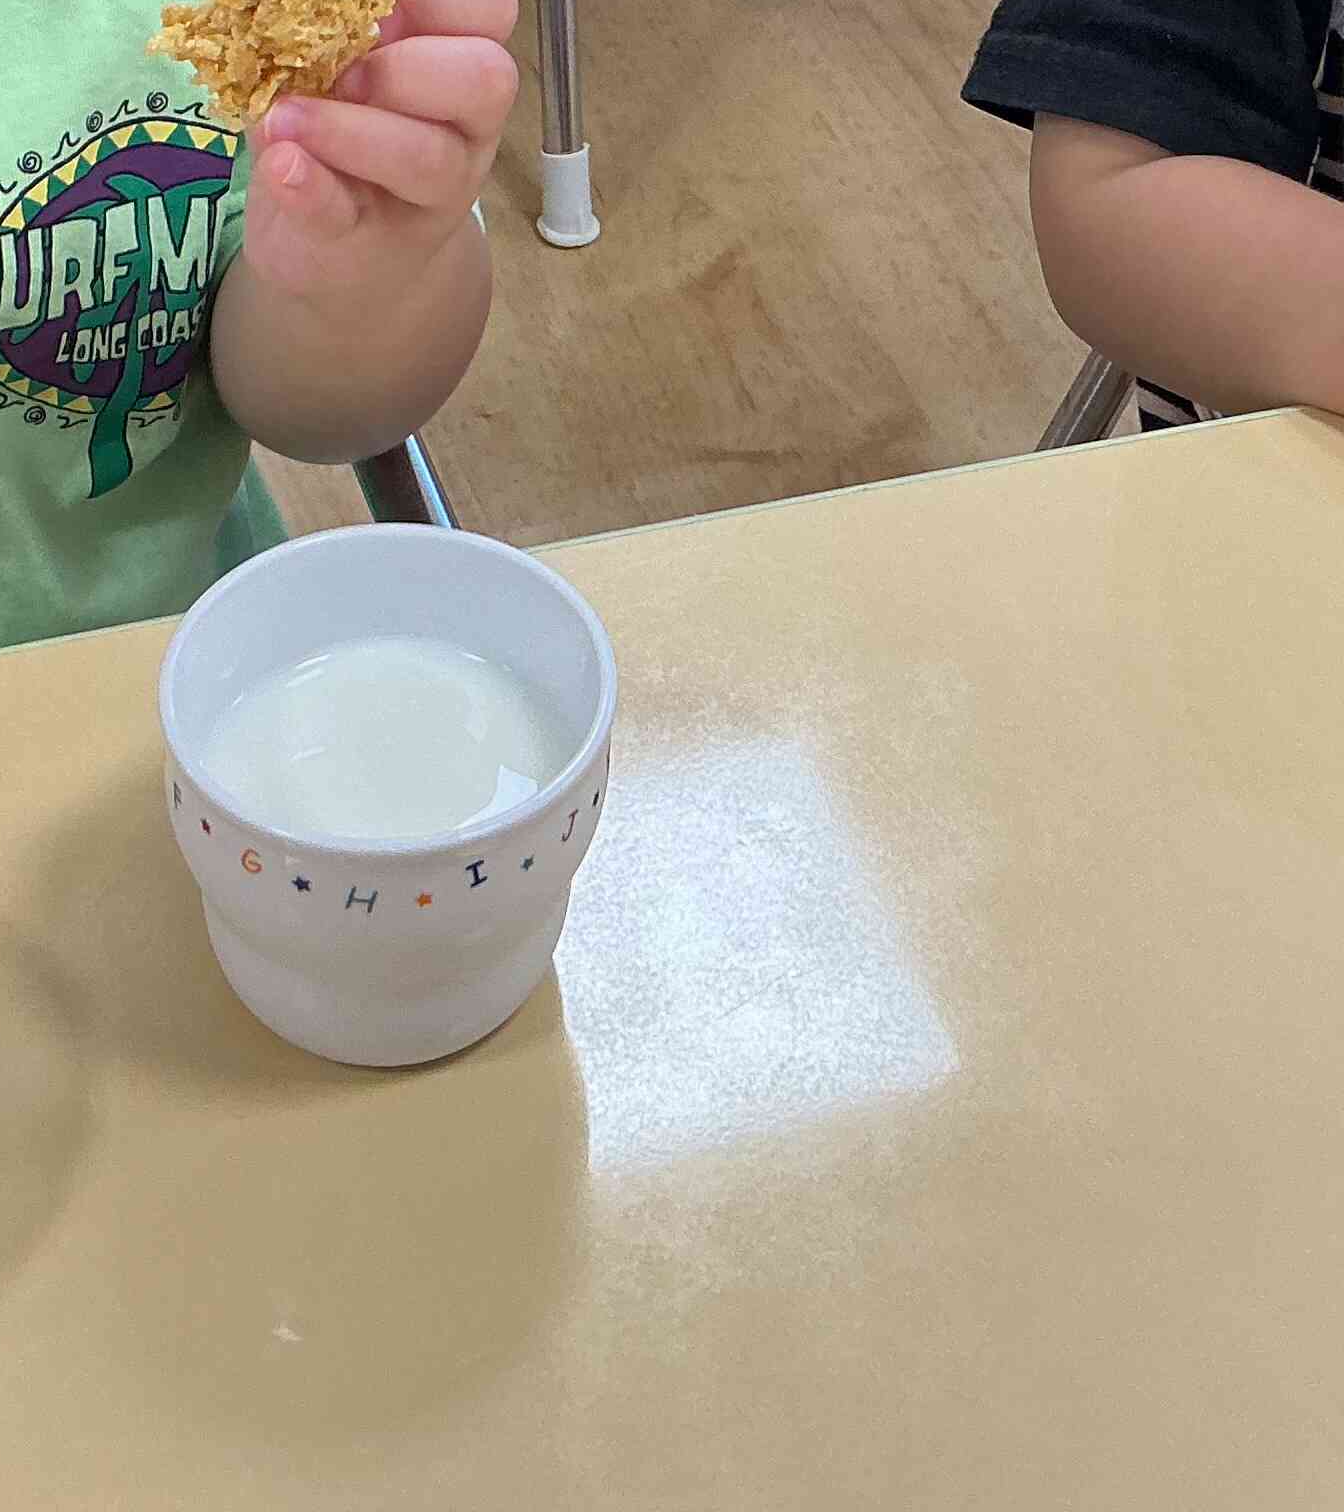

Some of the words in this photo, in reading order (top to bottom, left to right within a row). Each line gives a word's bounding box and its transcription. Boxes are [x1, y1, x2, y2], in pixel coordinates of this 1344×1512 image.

[56, 321, 128, 364] LONG
[240, 848, 264, 875] G
[345, 885, 379, 915] H
[465, 859, 489, 889] I
[561, 808, 580, 843] J
